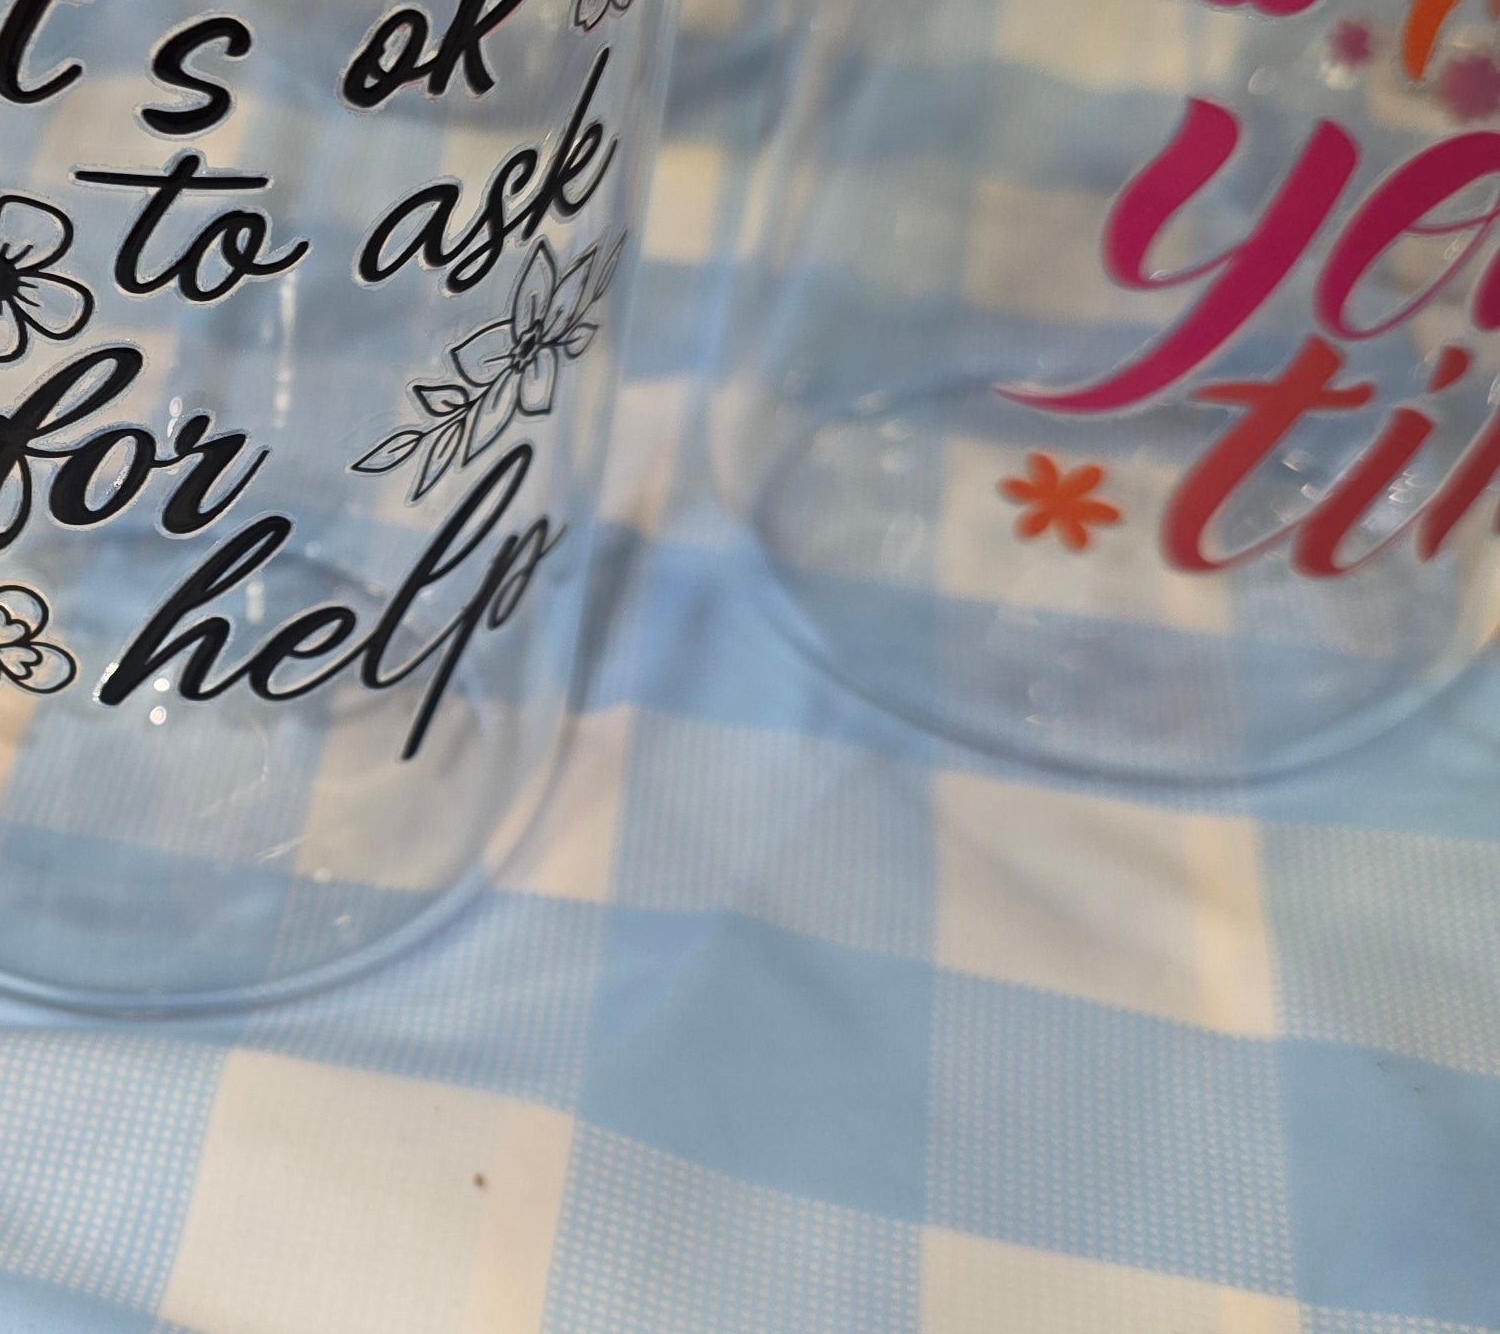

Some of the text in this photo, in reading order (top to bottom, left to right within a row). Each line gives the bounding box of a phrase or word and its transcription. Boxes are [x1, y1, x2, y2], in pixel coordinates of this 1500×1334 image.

[72, 47, 618, 302] to ask
[995, 97, 1500, 413] yo
[1161, 335, 1500, 578] ti
[100, 443, 567, 760] help
